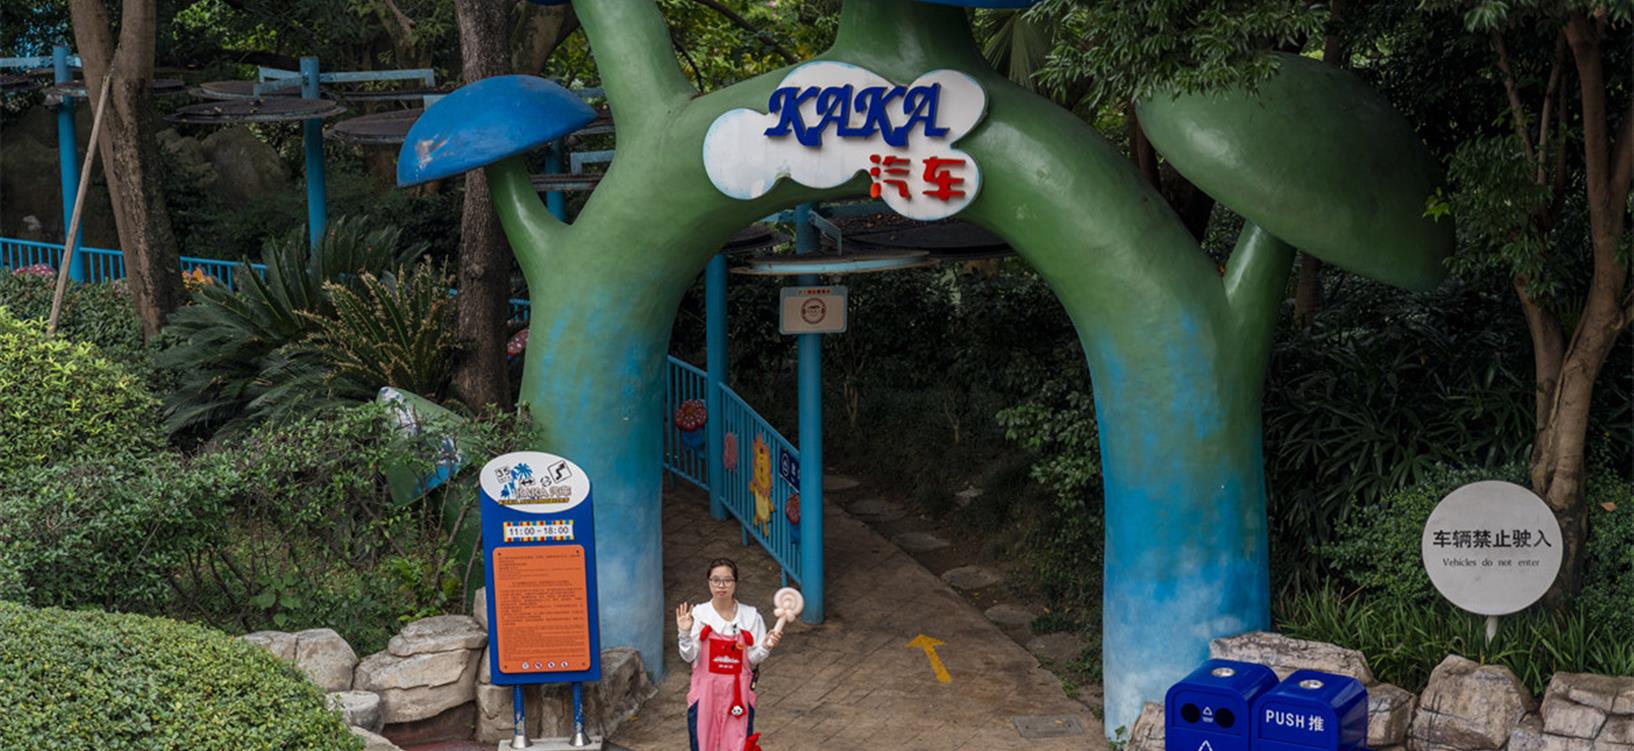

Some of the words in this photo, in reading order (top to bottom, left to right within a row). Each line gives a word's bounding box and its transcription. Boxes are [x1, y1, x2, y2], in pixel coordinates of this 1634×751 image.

[764, 83, 950, 147] KAKA
[869, 154, 967, 202] 汽车
[1432, 529, 1552, 548] 车辆禁止驶入
[1442, 558, 1477, 567] Vehicles
[1481, 558, 1493, 567] do
[1498, 558, 1512, 567] not
[1518, 559, 1540, 567] enter
[1265, 709, 1305, 729] PUSH
[1308, 714, 1325, 732] 推
